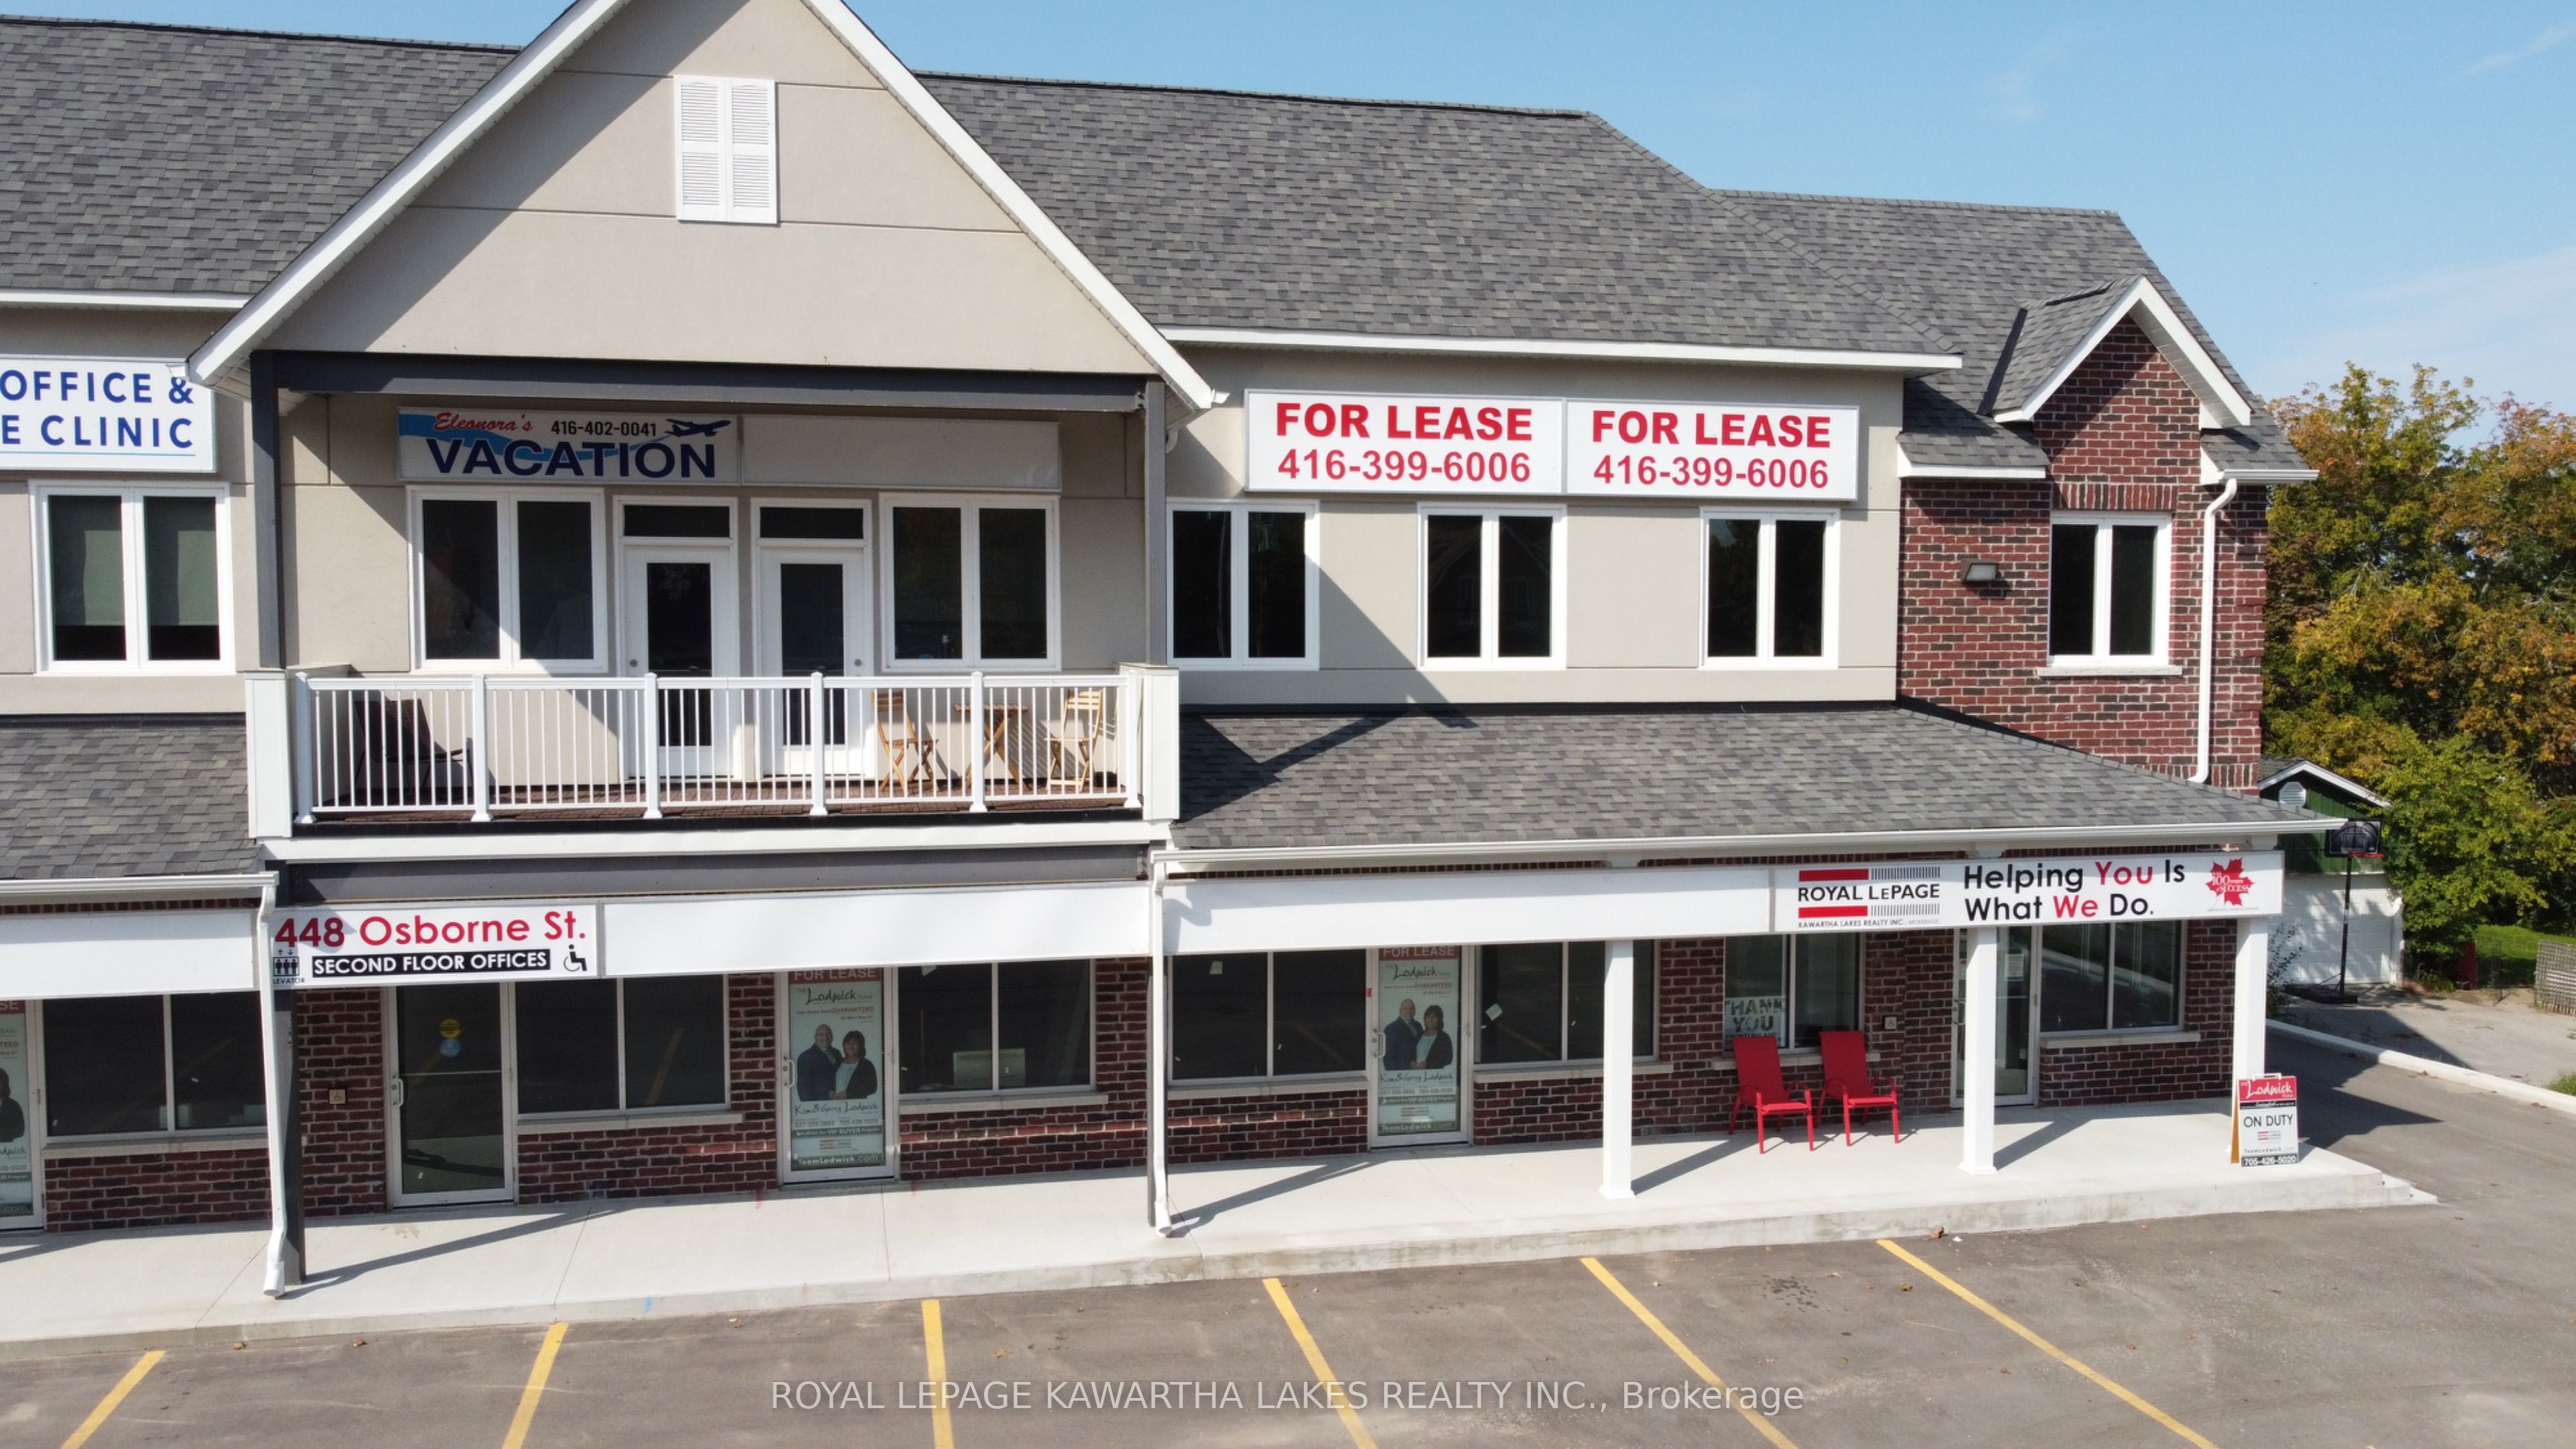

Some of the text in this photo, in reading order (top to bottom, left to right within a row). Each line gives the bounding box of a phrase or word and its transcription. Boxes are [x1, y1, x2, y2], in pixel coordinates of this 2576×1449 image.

[0, 369, 194, 404] OFFICE &
[40, 415, 193, 449] CLINIC
[434, 412, 533, 431] Eleonora's
[551, 420, 657, 437] 416-402-0041
[1276, 402, 1533, 441] FOR LEASE
[1593, 410, 1831, 448] FOR LEASE
[426, 438, 715, 478] VACATION
[1278, 448, 1531, 482] 416-399-6006
[1594, 454, 1829, 488] 416-399-6006
[1964, 859, 2186, 893] Helping You Is
[1798, 885, 1864, 902] ROYAL
[1964, 893, 2154, 922] What We Do.
[274, 910, 586, 949] 448 Osborne St.
[1798, 920, 1838, 928] KAWARTHA
[1839, 919, 1862, 927] LAKES
[1862, 918, 1888, 927] REALTY
[314, 951, 547, 975] SECOND FLOOR OFFICES
[1383, 946, 1455, 957] FOR LEASE
[794, 967, 876, 981] FOR LEASE
[1732, 1015, 1774, 1032] YOU
[2243, 1114, 2294, 1128] ON DUTY
